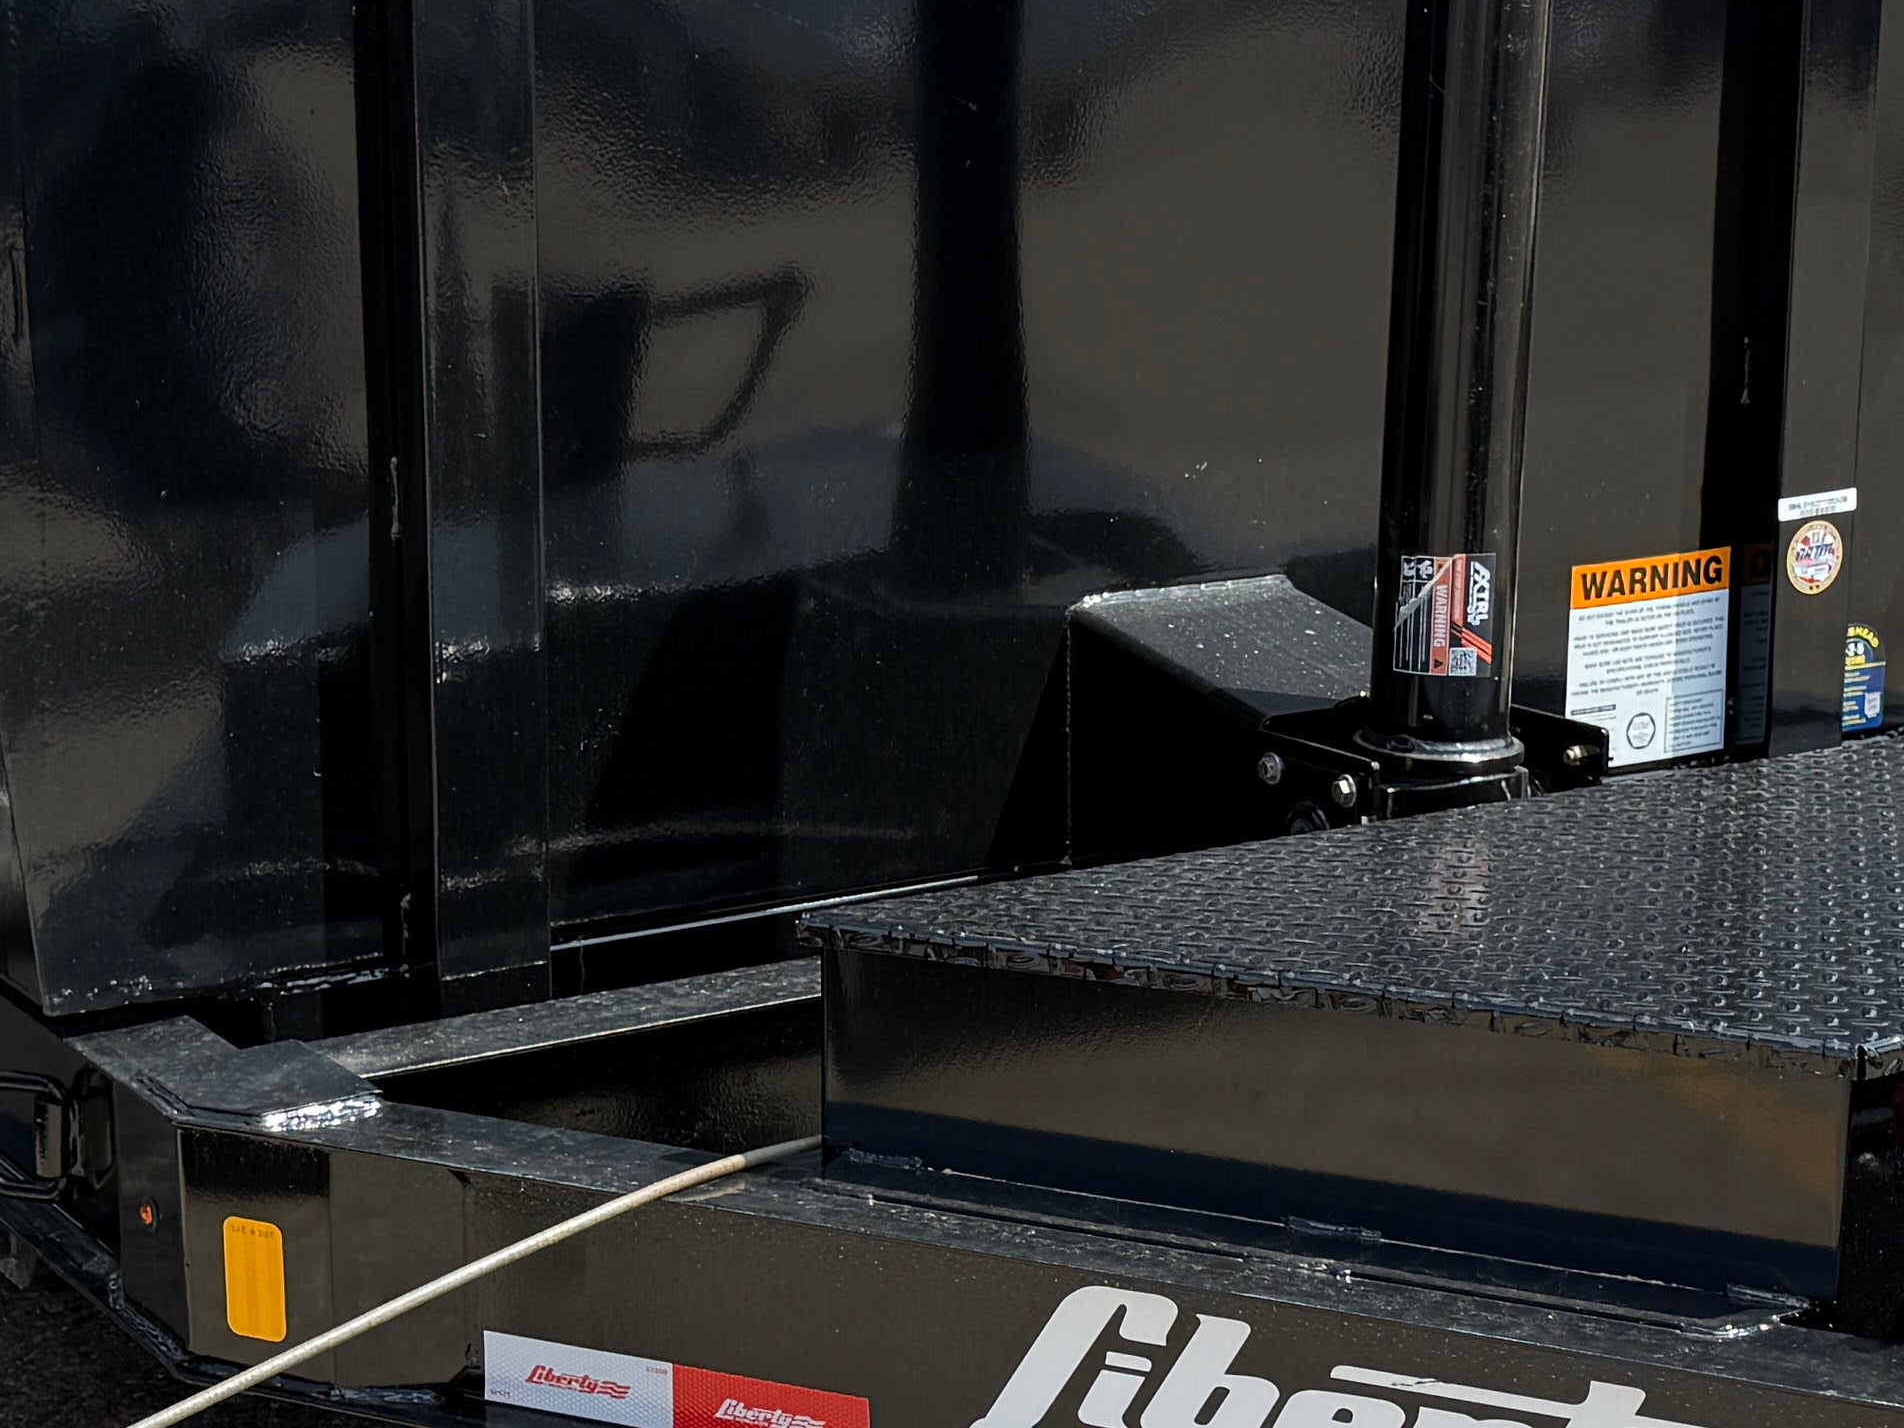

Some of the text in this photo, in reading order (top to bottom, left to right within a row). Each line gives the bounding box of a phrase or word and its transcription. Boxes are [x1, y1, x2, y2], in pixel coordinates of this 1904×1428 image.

[1581, 555, 1723, 601] WARNING
[1433, 584, 1449, 648] WARNING
[526, 1365, 600, 1395] Liberty
